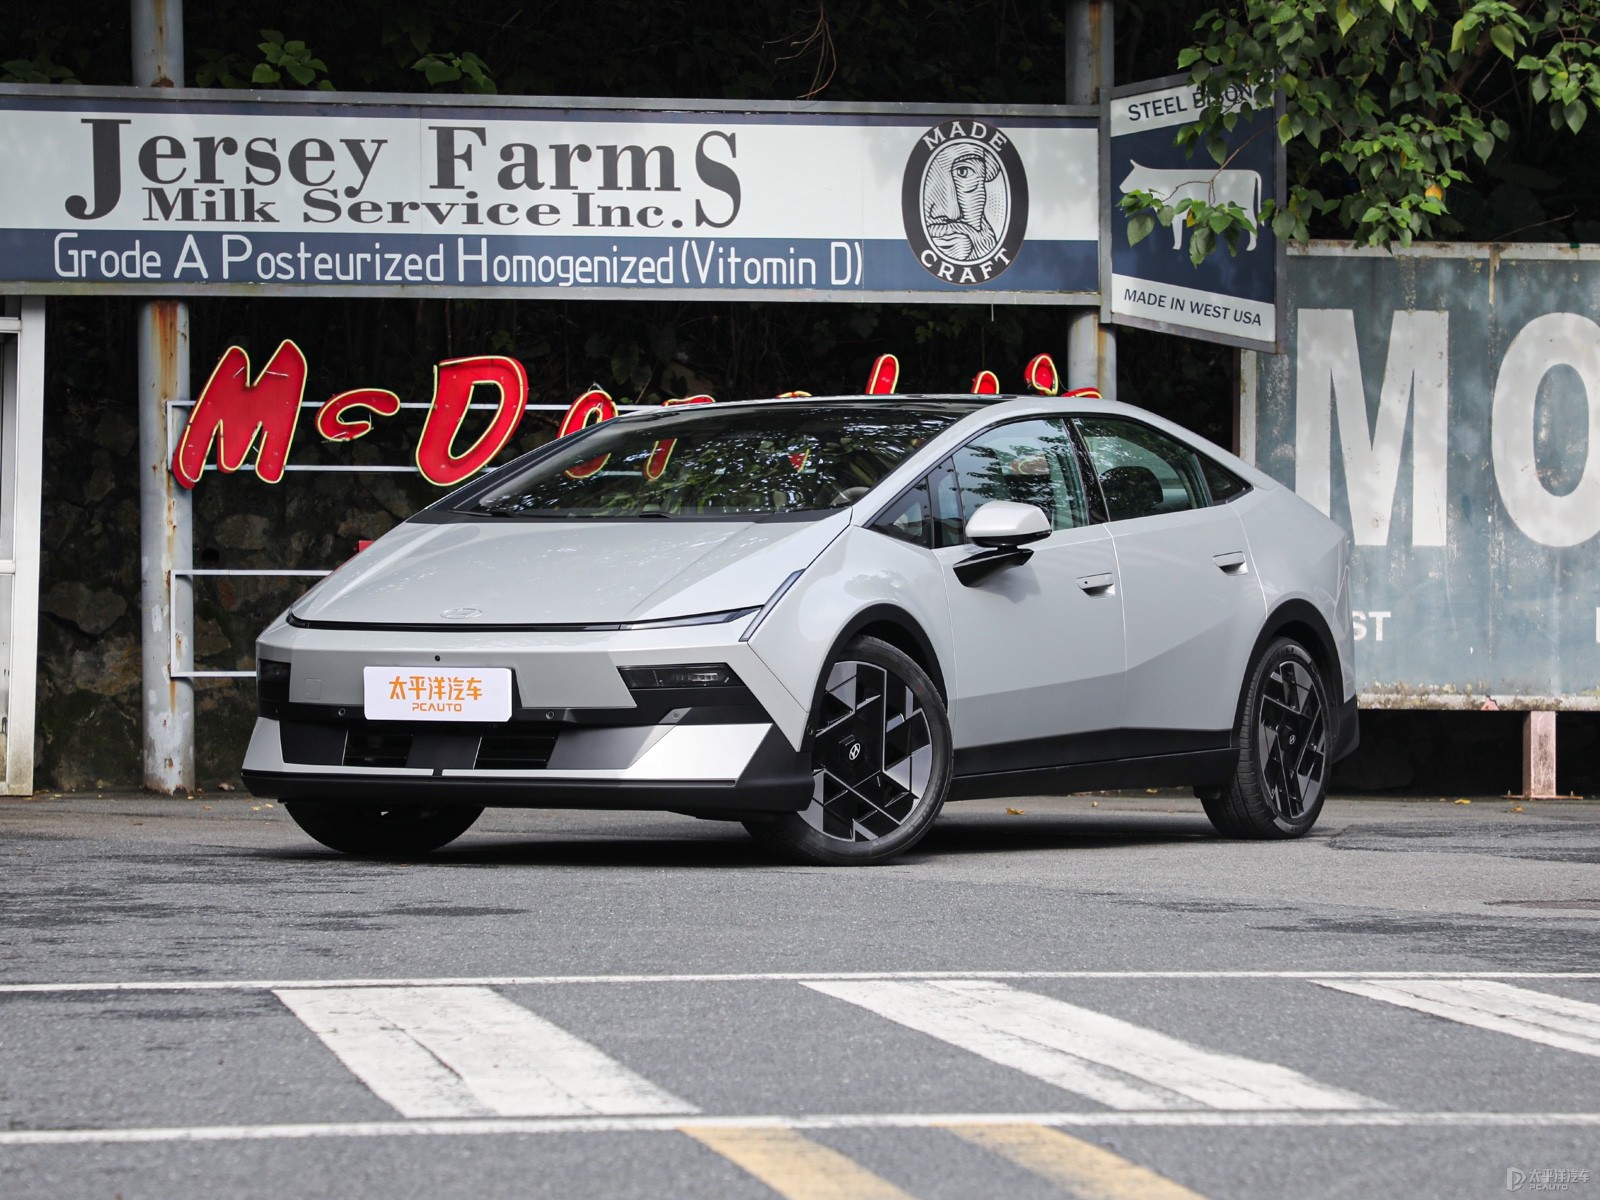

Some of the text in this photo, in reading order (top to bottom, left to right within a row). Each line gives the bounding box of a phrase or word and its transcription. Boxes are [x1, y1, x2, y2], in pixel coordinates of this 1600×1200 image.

[1128, 95, 1188, 121] STEEL
[922, 121, 1008, 152] MADE
[64, 118, 388, 221] Jersey
[142, 187, 684, 229] Milk Service Inc.
[54, 232, 162, 278] Grode
[173, 234, 209, 279] A
[222, 234, 444, 282] Posteurized
[457, 237, 674, 287] Homogenized
[830, 241, 863, 286] D)
[920, 247, 1011, 283] CRAFT
[1124, 288, 1262, 327] MADE IN WEST USA
[389, 675, 483, 701] 太平洋汽车
[412, 702, 463, 712] PCAUTO
